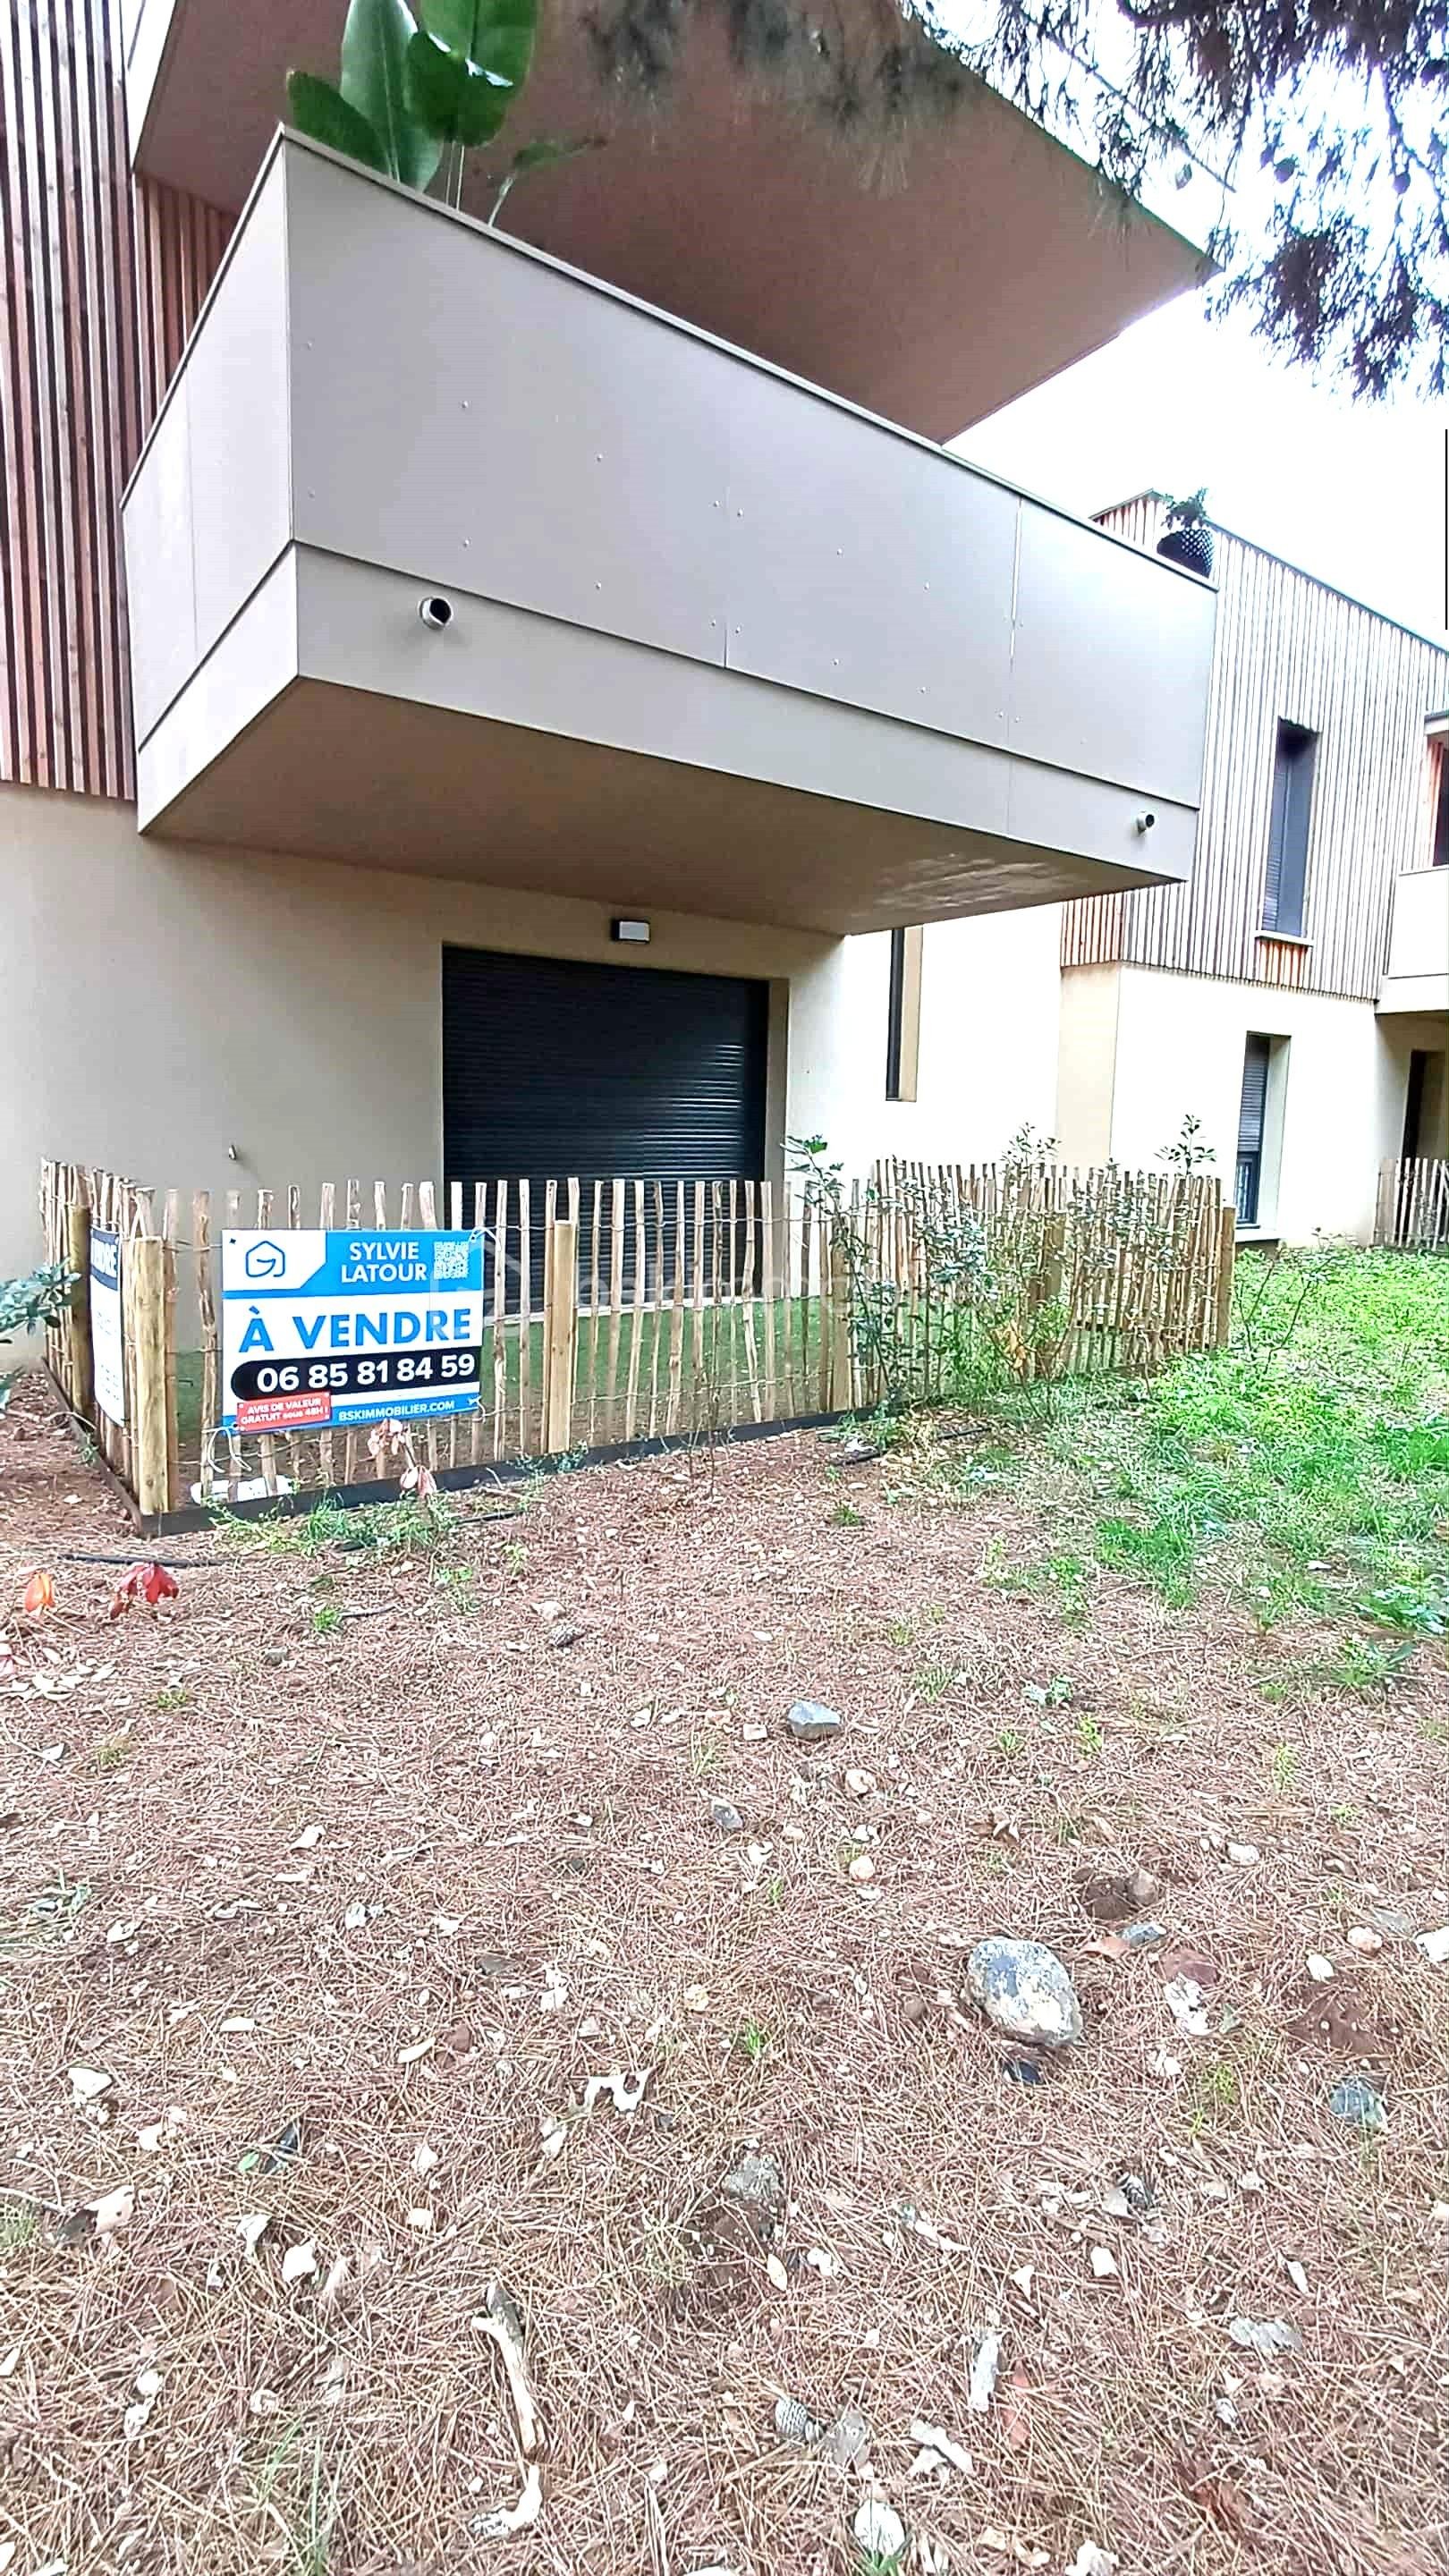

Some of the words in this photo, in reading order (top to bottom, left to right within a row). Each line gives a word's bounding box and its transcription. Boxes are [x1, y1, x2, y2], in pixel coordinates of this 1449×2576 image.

[349, 1241, 419, 1262] SYLVIE
[341, 1263, 428, 1284] LATOUR
[238, 1305, 275, 1353] À
[291, 1308, 471, 1350] VENDRE
[257, 1366, 300, 1393] 06
[308, 1363, 348, 1388] 85
[357, 1360, 388, 1385] 81
[396, 1356, 433, 1382] 84
[440, 1353, 476, 1378] 59
[247, 1405, 269, 1415] AVIS
[270, 1402, 284, 1412] DE
[286, 1398, 322, 1409] VALEUR
[338, 1400, 455, 1421] BSKIMMOBILIER.COM
[241, 1412, 282, 1425] GRATUIT
